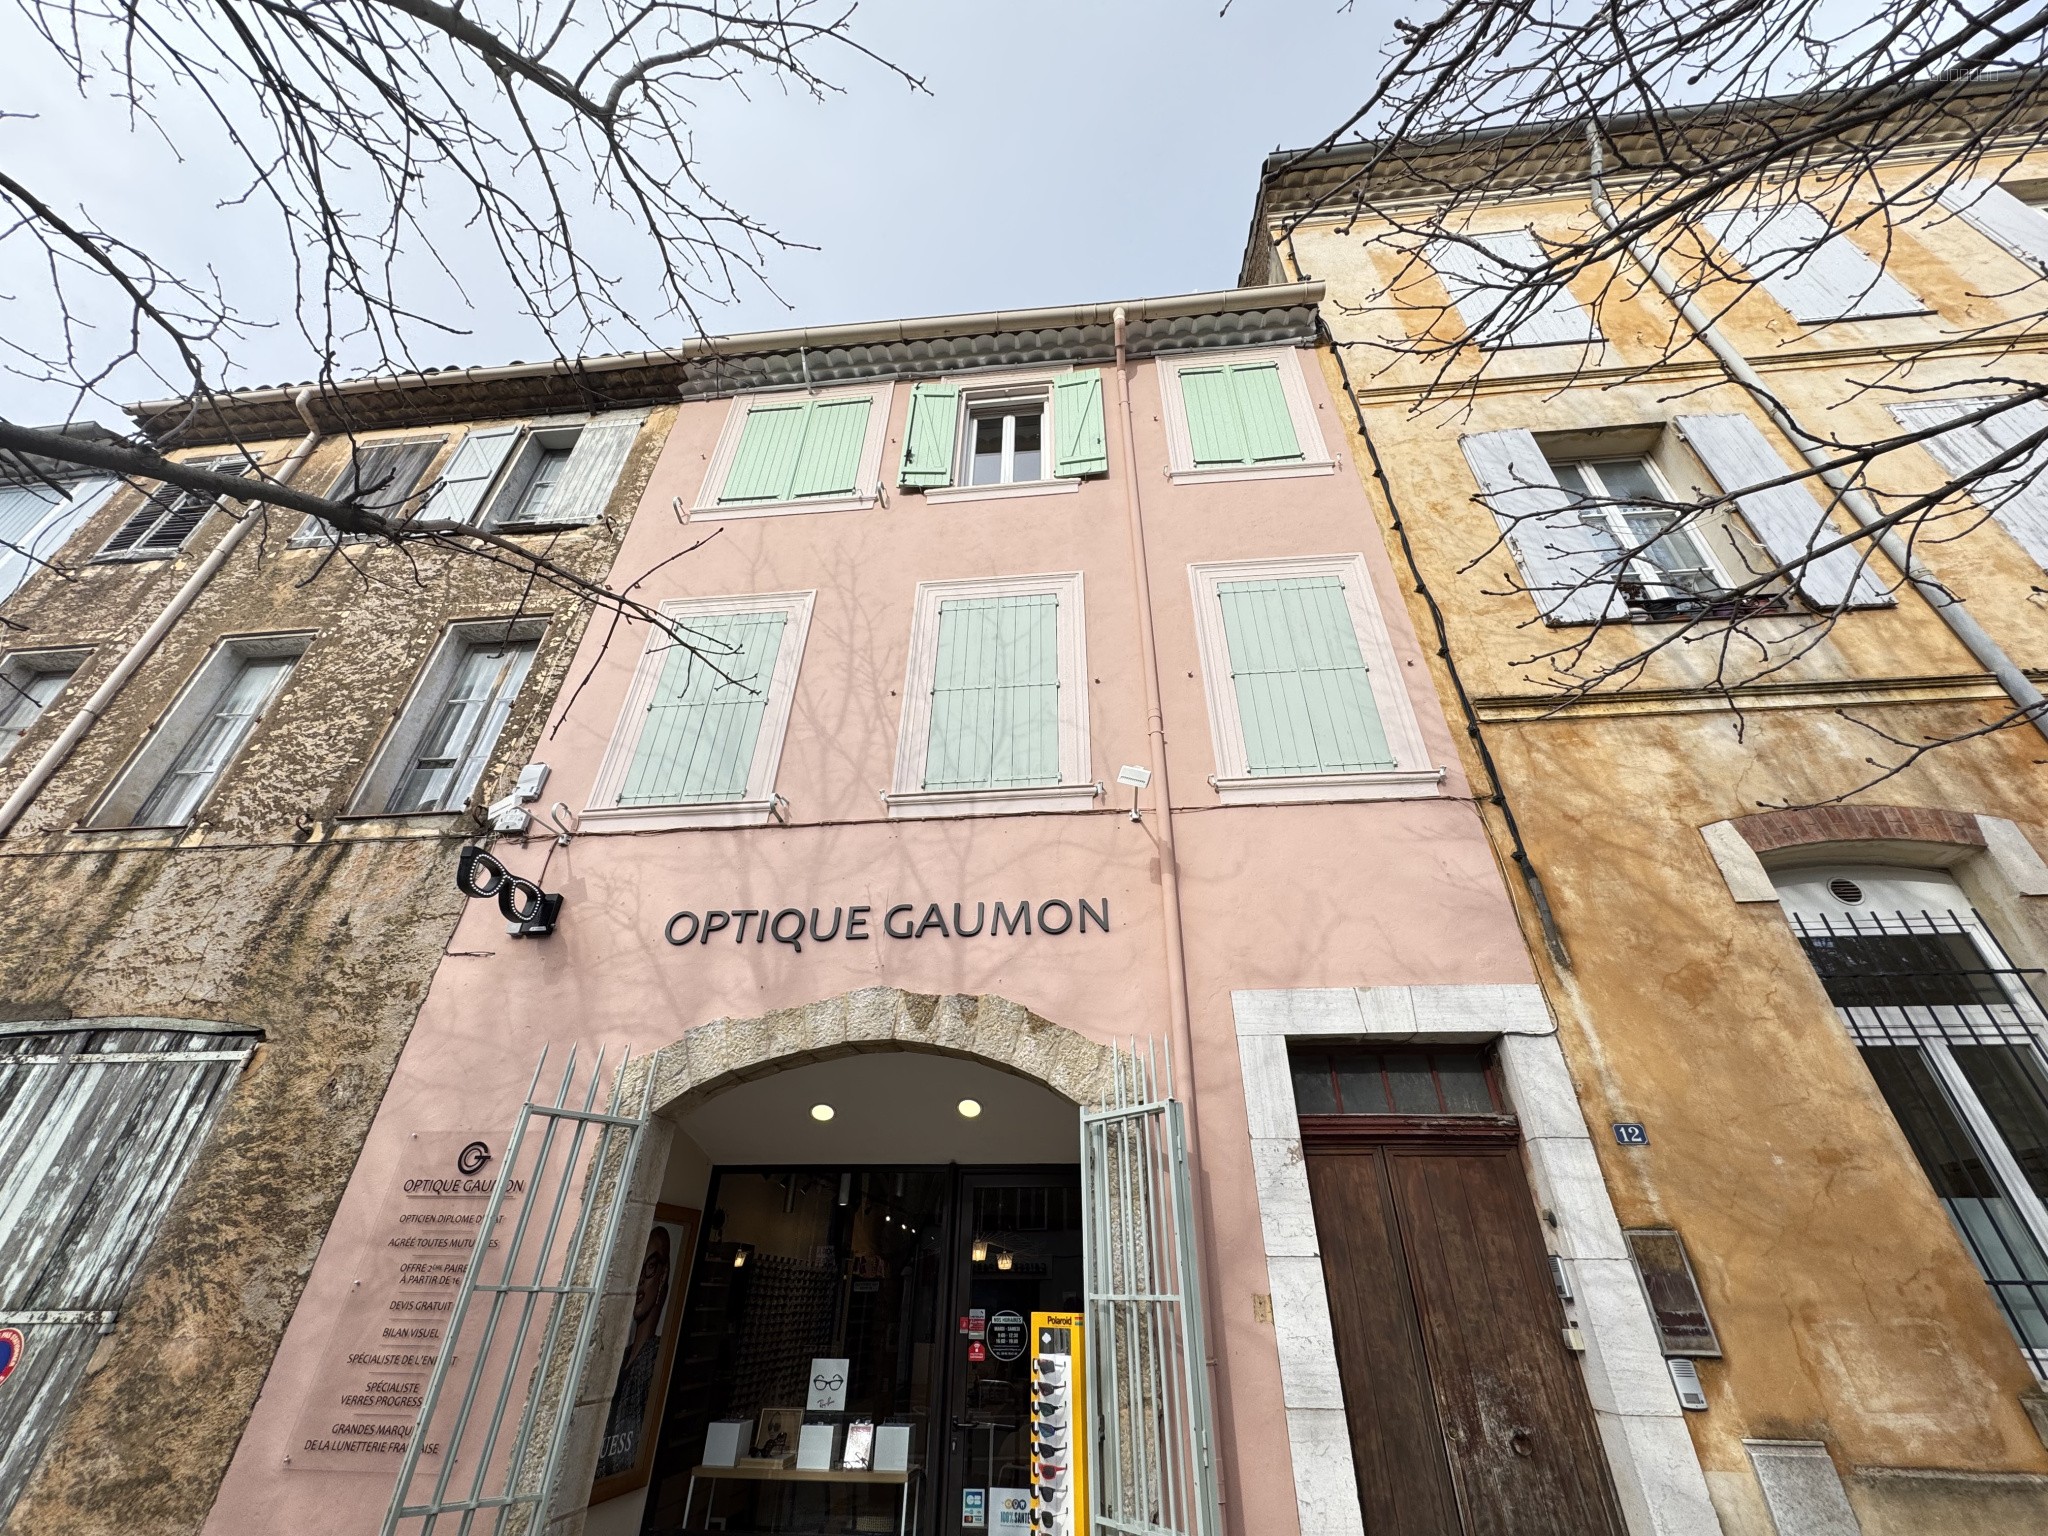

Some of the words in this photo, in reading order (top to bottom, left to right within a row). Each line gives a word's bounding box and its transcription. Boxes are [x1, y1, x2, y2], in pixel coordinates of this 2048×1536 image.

[664, 905, 871, 952] OPTIQUE
[883, 897, 1110, 939] GAUMON
[1619, 1127, 1642, 1142] 12
[403, 1179, 461, 1195] OPTIQUE
[399, 1214, 436, 1223] OPTICIEN
[437, 1215, 474, 1224] DIPLOME
[388, 1236, 415, 1247] AGRÉÉ
[416, 1238, 448, 1248] TOUTES
[449, 1238, 498, 1248] MUTUES
[400, 1263, 427, 1273] OFFRE
[443, 1264, 468, 1273] PAIRE
[399, 1273, 406, 1284] À
[407, 1275, 438, 1284] PARTIR
[439, 1275, 451, 1285] DE
[452, 1277, 460, 1285] 1€
[389, 1301, 414, 1310] DEVIS
[415, 1301, 453, 1311] GRATUIT
[1047, 1316, 1072, 1325] Polaroid
[382, 1327, 409, 1338] BILAN
[410, 1328, 440, 1338] VISUEL
[347, 1352, 400, 1365] SPÉCIALISTE
[401, 1354, 414, 1365] DE
[415, 1355, 458, 1366] L'ENT
[365, 1380, 420, 1393] SPÉCIALISTE
[341, 1395, 375, 1406] VERRES
[376, 1396, 424, 1407] PROGRESS
[331, 1423, 375, 1435] GRANDES
[376, 1425, 414, 1438] MARQU
[304, 1440, 318, 1450] DE
[318, 1440, 330, 1451] LA
[331, 1441, 388, 1453] LUNETTERIE
[599, 1430, 634, 1459] UESS
